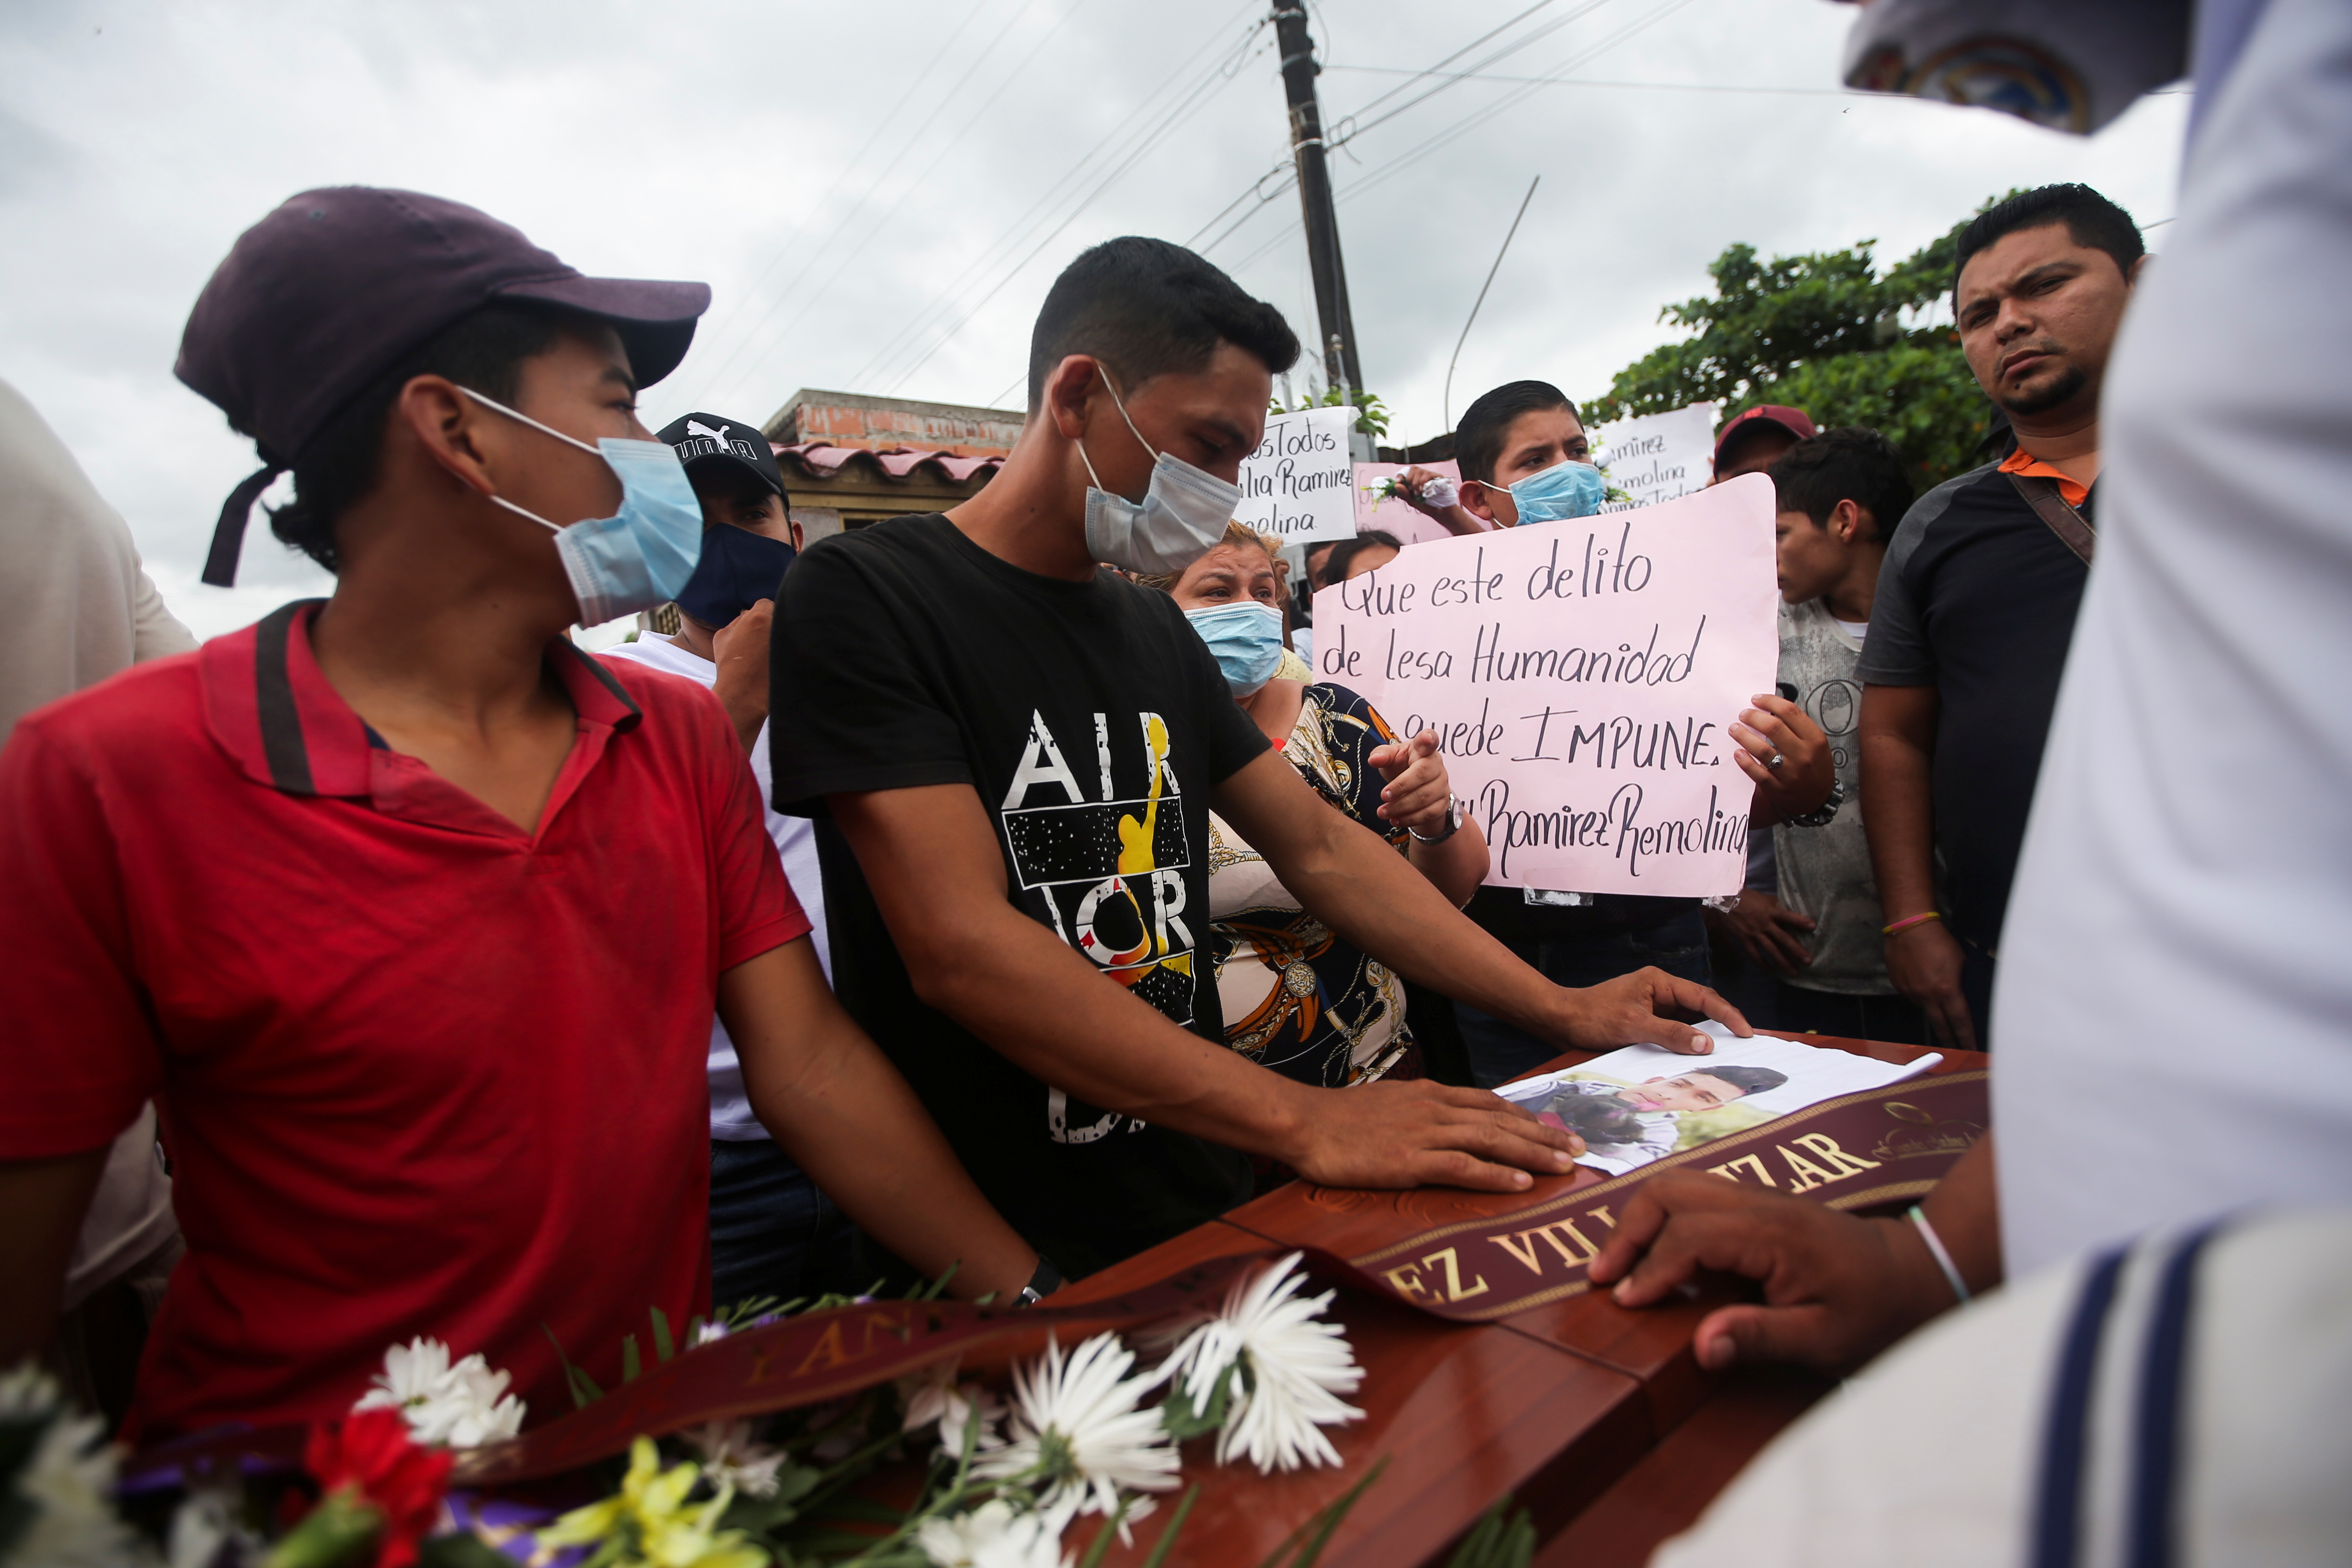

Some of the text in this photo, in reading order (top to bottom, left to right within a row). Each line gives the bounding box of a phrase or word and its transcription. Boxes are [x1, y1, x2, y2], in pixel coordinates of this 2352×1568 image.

[1264, 417, 1336, 456] Todos
[1611, 434, 1667, 461] mirez
[1239, 465, 1273, 499] ilia
[1275, 458, 1352, 499] Ramirez
[1618, 458, 1685, 488] molina
[1245, 503, 1317, 534] olina.
[1342, 522, 1651, 617] Que este delito
[1323, 614, 1706, 686] de lesa Humanidad
[1001, 709, 1181, 810] AIR
[1480, 779, 1749, 878] Ramirez Remolina
